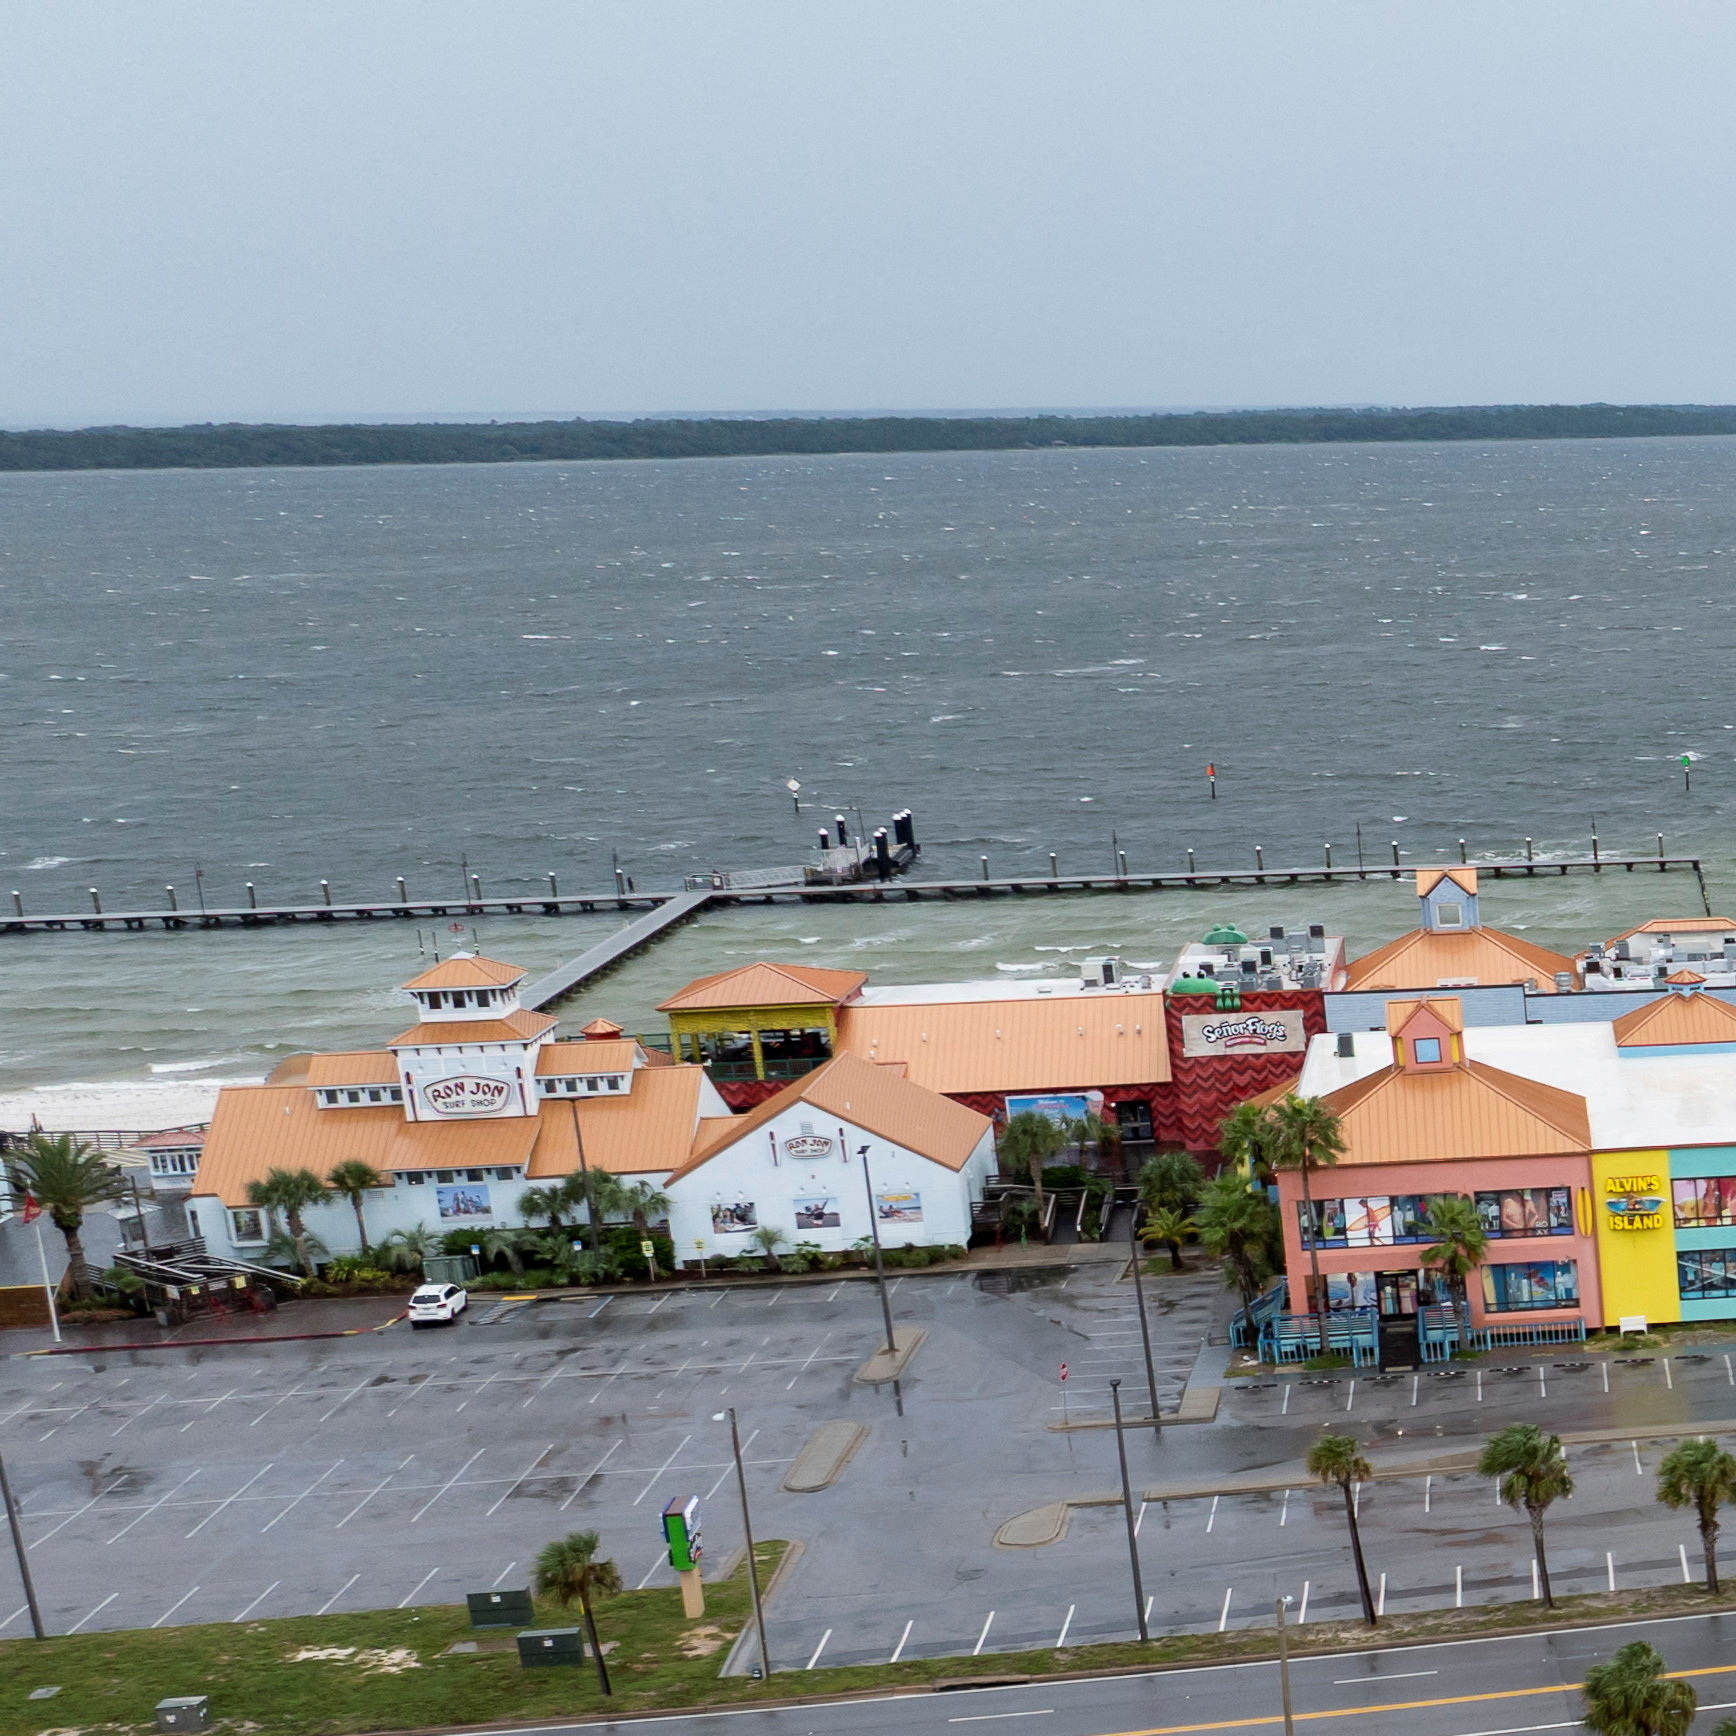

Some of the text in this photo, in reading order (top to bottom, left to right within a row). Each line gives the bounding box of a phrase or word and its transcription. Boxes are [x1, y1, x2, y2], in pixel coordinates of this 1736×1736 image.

[1202, 1021, 1246, 1043] Señor
[432, 1082, 504, 1102] RON JON
[443, 1098, 497, 1109] SURF SHOP
[1606, 1175, 1660, 1193] ALVIN'S
[1609, 1213, 1664, 1230] ISLAND
